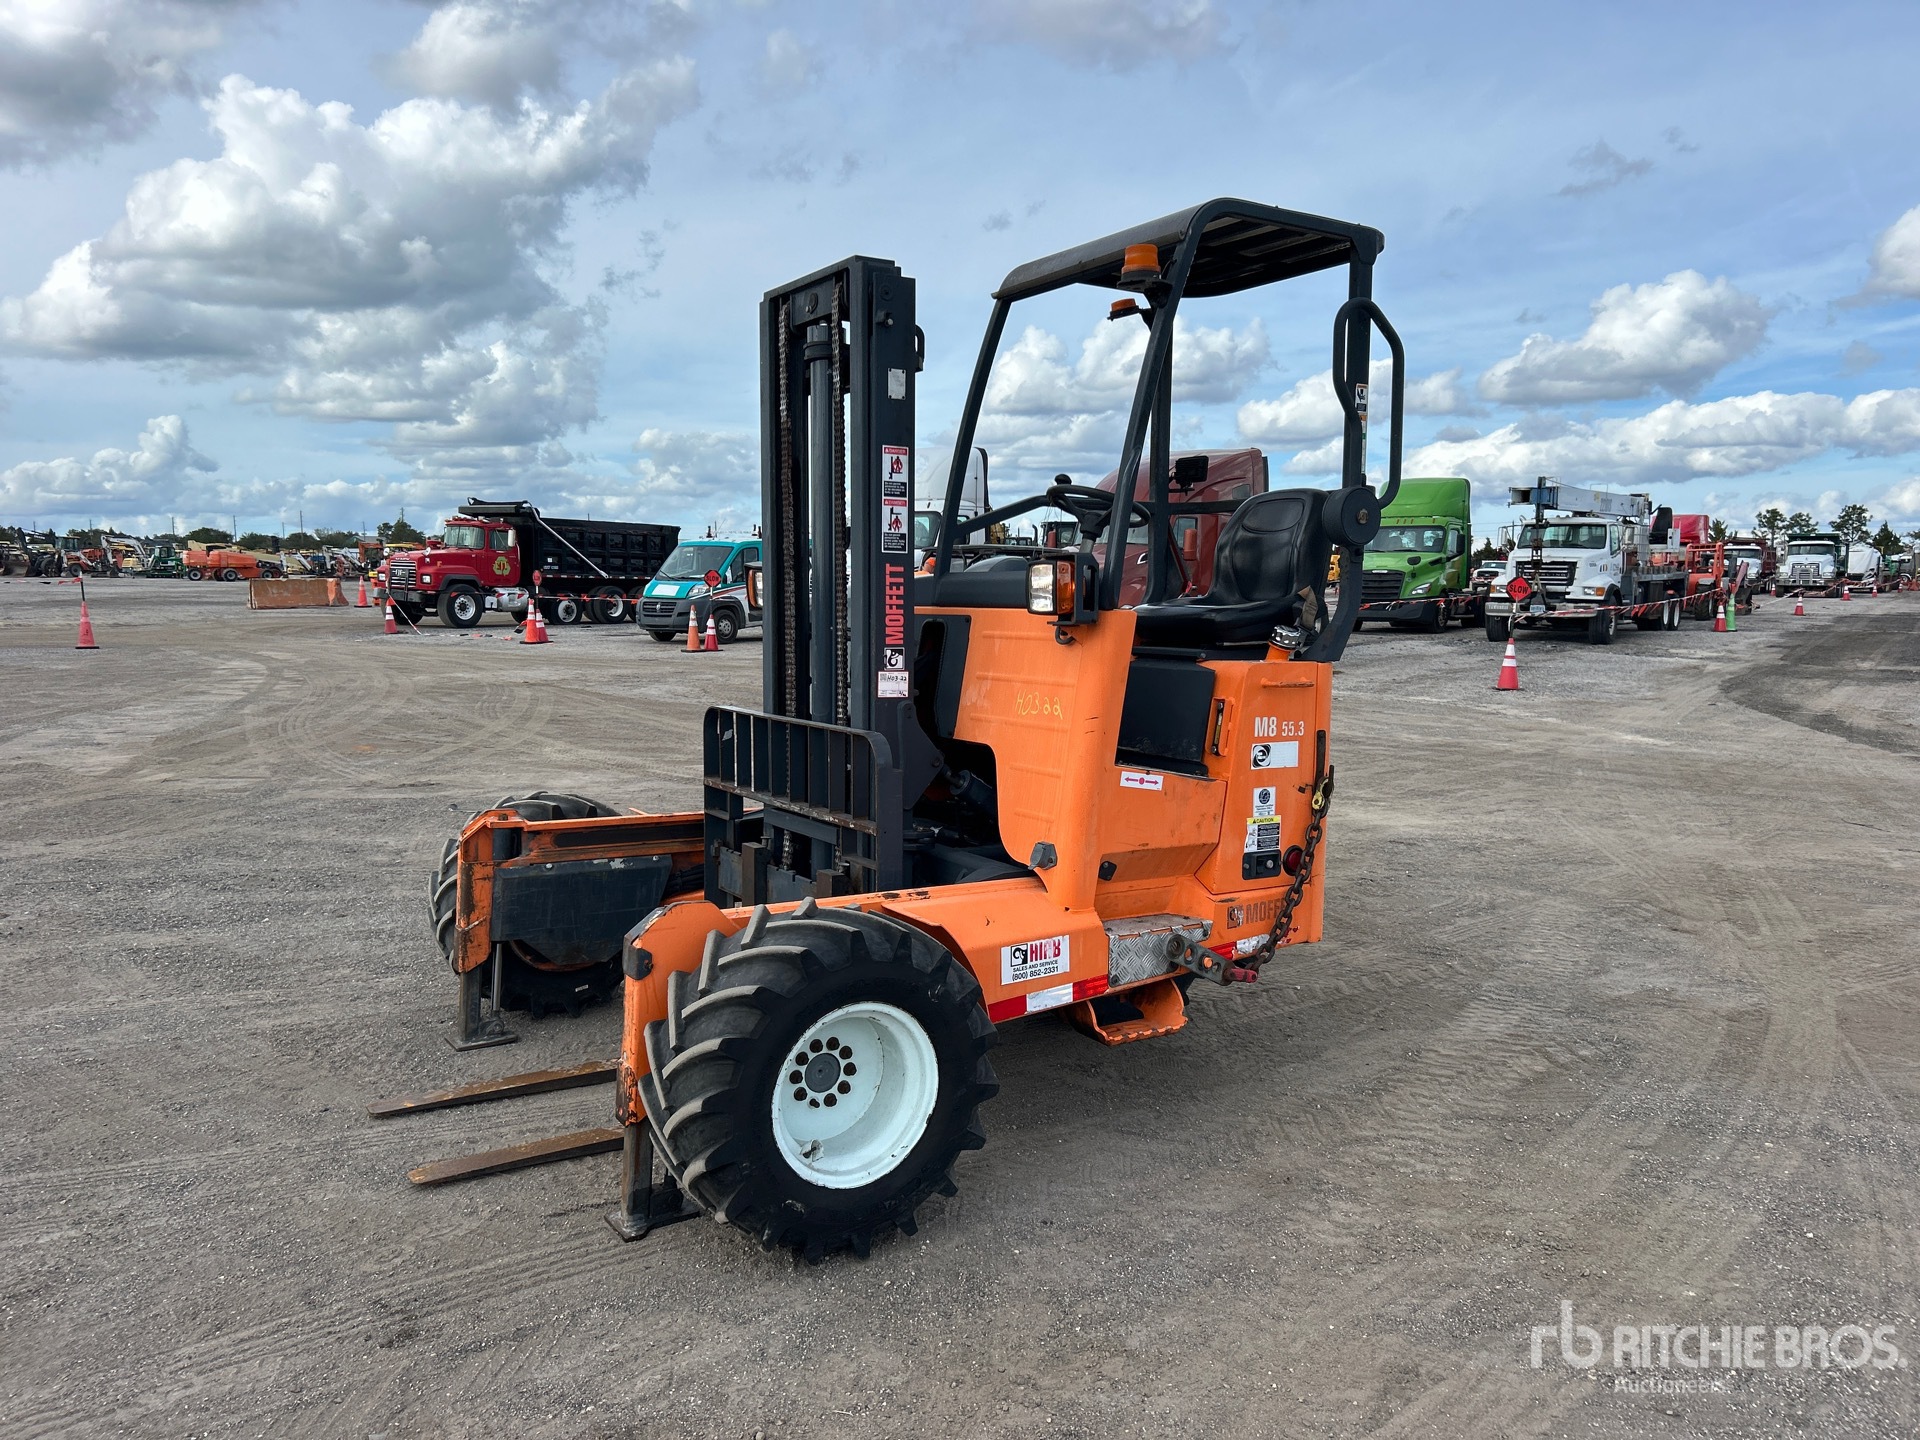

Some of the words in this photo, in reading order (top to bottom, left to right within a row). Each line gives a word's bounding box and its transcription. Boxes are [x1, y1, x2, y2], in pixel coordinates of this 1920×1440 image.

[1509, 584, 1529, 594] SLOW
[885, 563, 904, 645] MOFFETT
[1254, 716, 1277, 738] M8
[1281, 721, 1305, 737] 55.3
[1012, 971, 1028, 982] (800)
[1029, 966, 1059, 978] 852-2331
[1013, 965, 1028, 973] SALES
[1039, 960, 1058, 968] SERVICE
